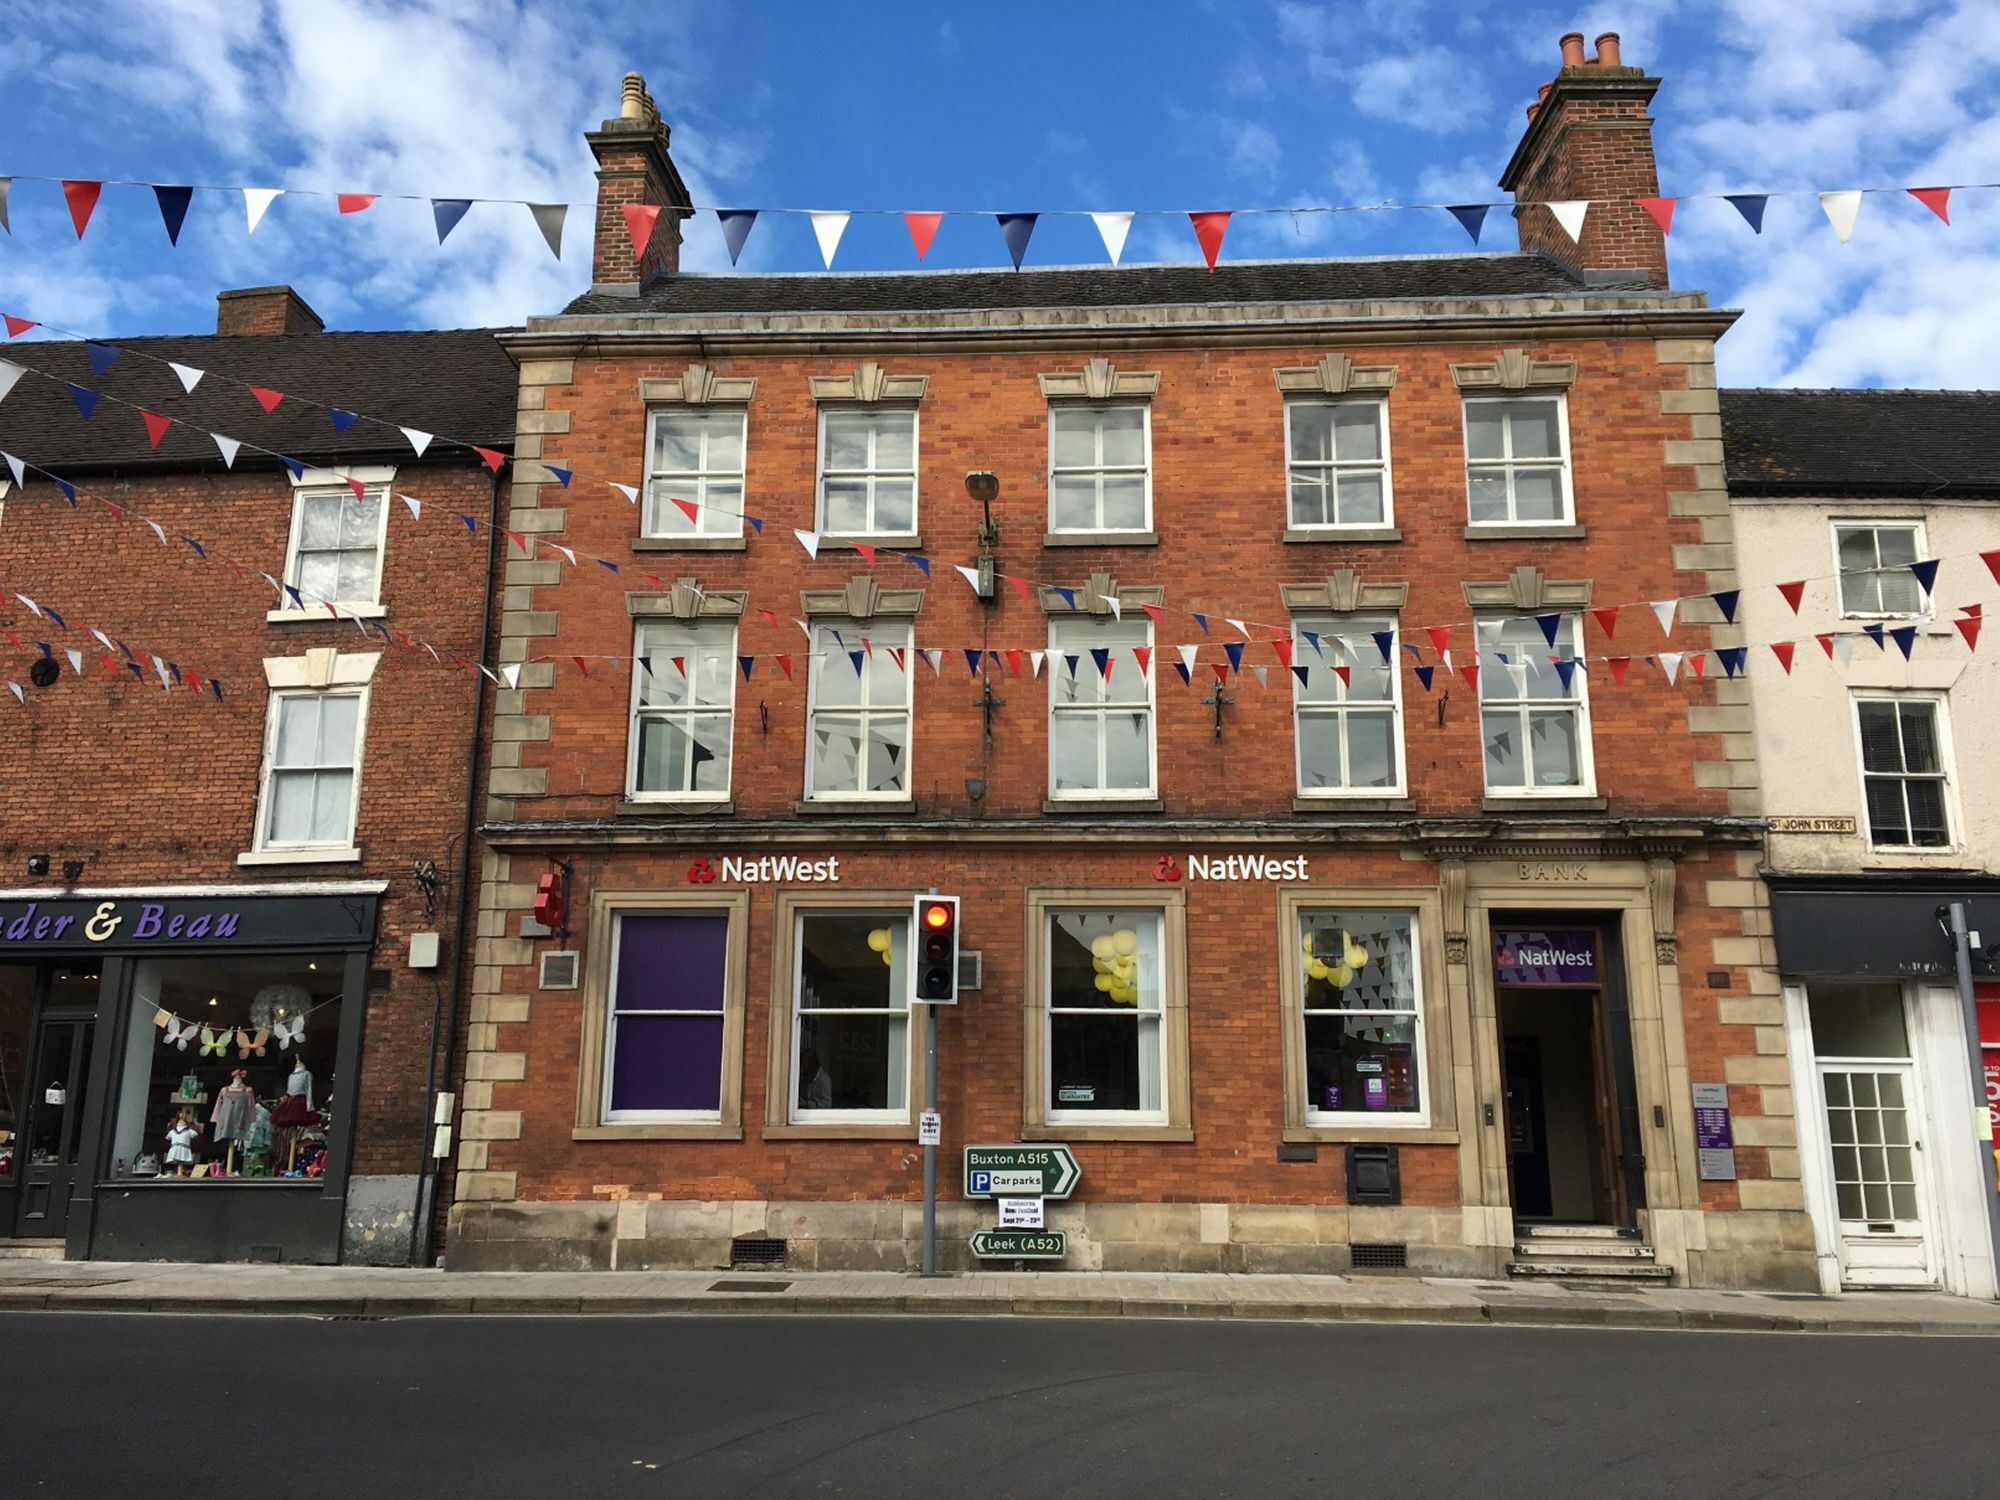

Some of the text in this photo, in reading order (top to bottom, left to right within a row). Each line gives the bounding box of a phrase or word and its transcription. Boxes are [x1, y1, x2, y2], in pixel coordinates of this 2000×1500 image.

[1783, 819, 1811, 829] JOHN
[1814, 820, 1853, 830] STREET
[721, 856, 839, 881] NatWest
[1187, 854, 1309, 880] NatWest
[1518, 863, 1588, 880] BANK
[0, 902, 241, 942] der & Beau
[1518, 949, 1593, 966] NatWest
[970, 1153, 1048, 1165] Buxton A515
[976, 1174, 1041, 1190] P Car parks
[987, 1237, 1061, 1251] Leek (A52)
